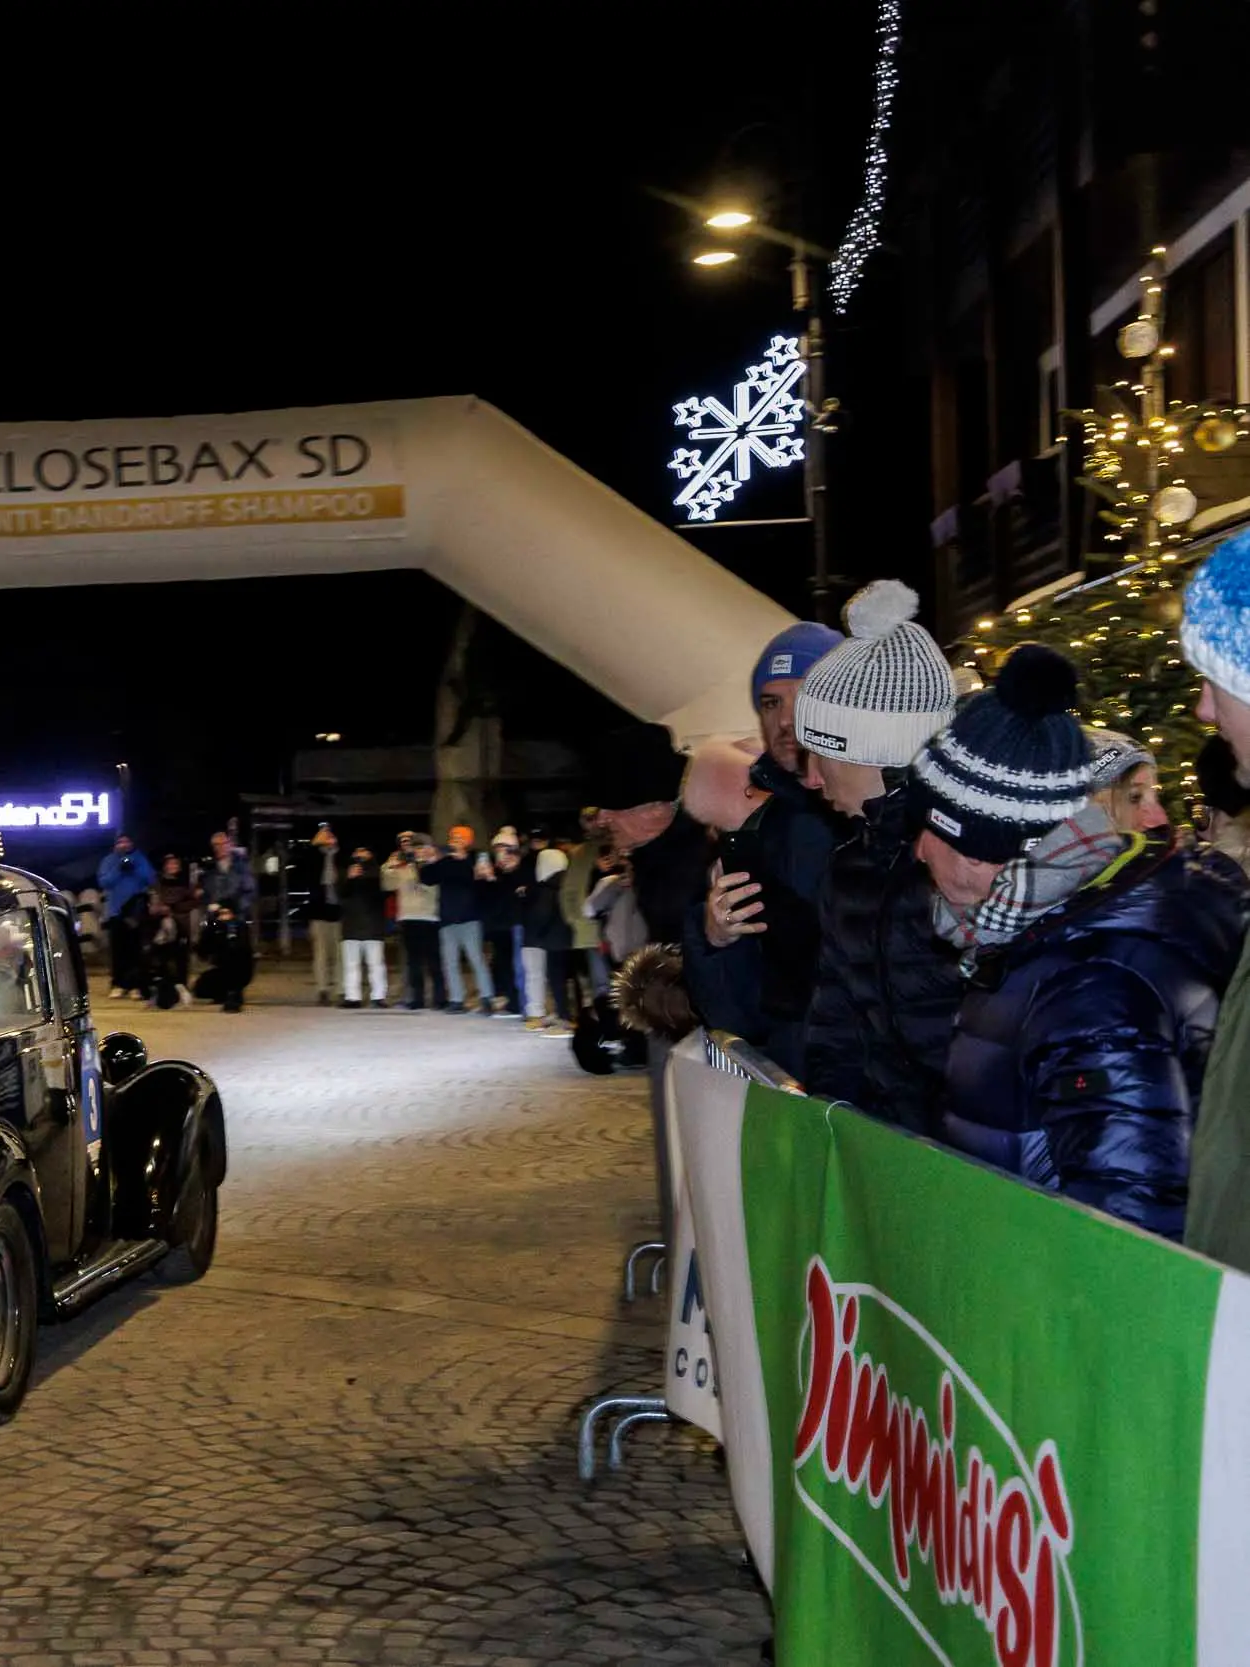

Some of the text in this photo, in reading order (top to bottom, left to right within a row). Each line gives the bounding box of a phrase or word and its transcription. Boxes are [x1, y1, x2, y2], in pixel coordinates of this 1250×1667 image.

[298, 434, 370, 478] SD
[222, 491, 374, 521] SHAMPOO
[804, 730, 845, 750] Eisbär
